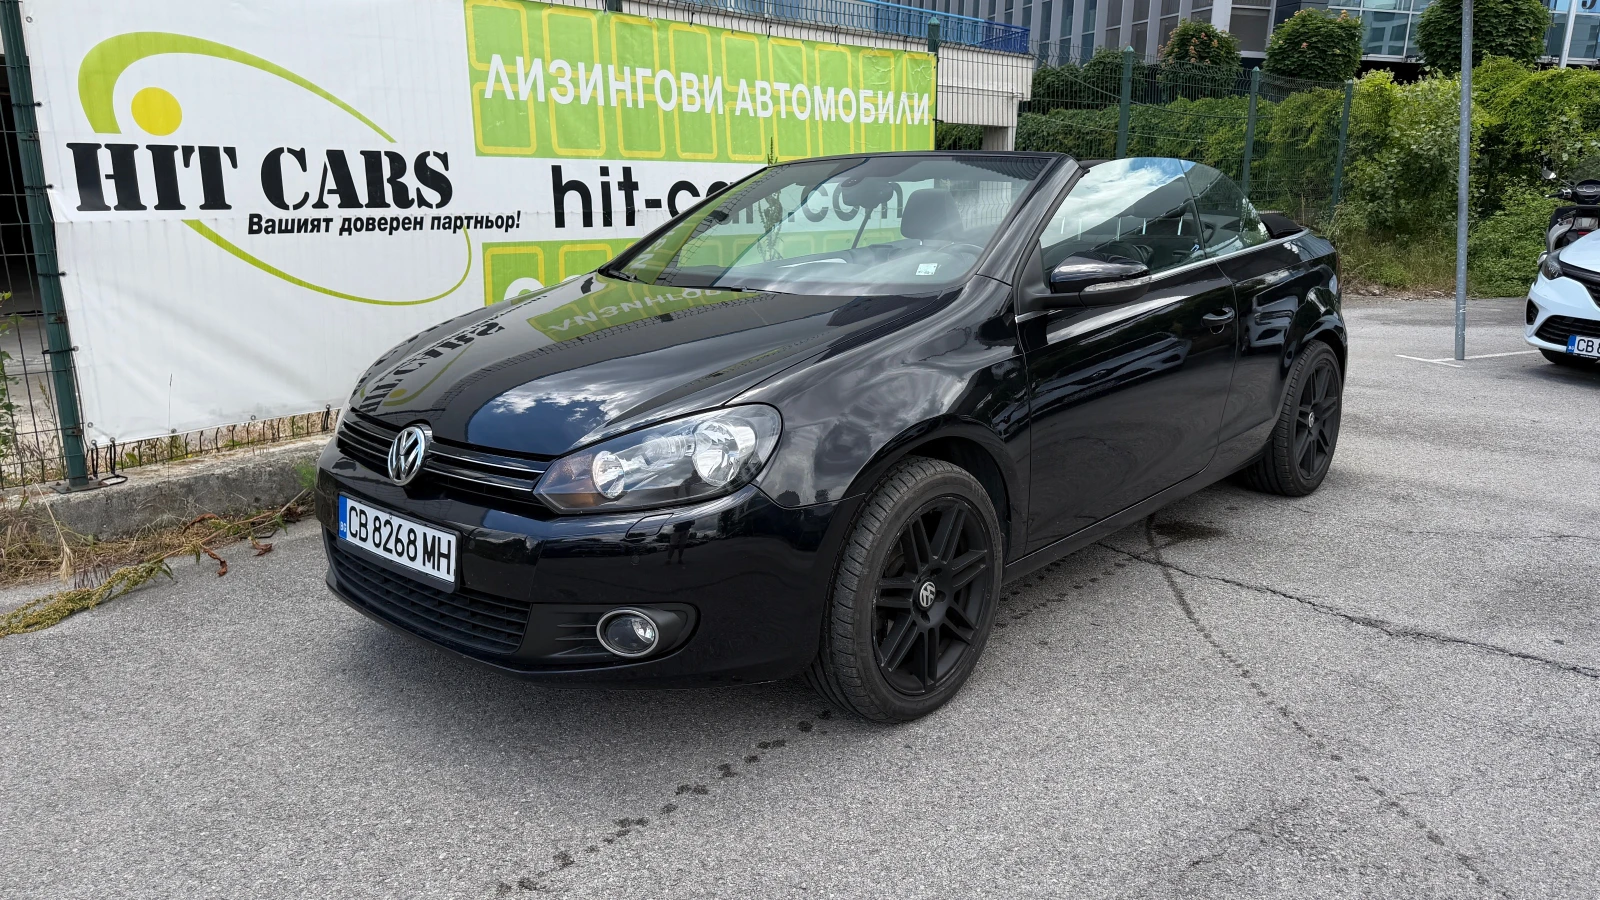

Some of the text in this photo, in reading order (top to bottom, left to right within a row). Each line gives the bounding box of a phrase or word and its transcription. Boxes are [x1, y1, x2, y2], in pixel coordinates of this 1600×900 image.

[484, 53, 929, 126] ЛИЗИНГОВИ АВТОМОБИЛИ
[66, 142, 454, 211] HIT CARS
[248, 210, 522, 236] Вашият доверен партньор!
[348, 505, 452, 576] CB 8268 MH
